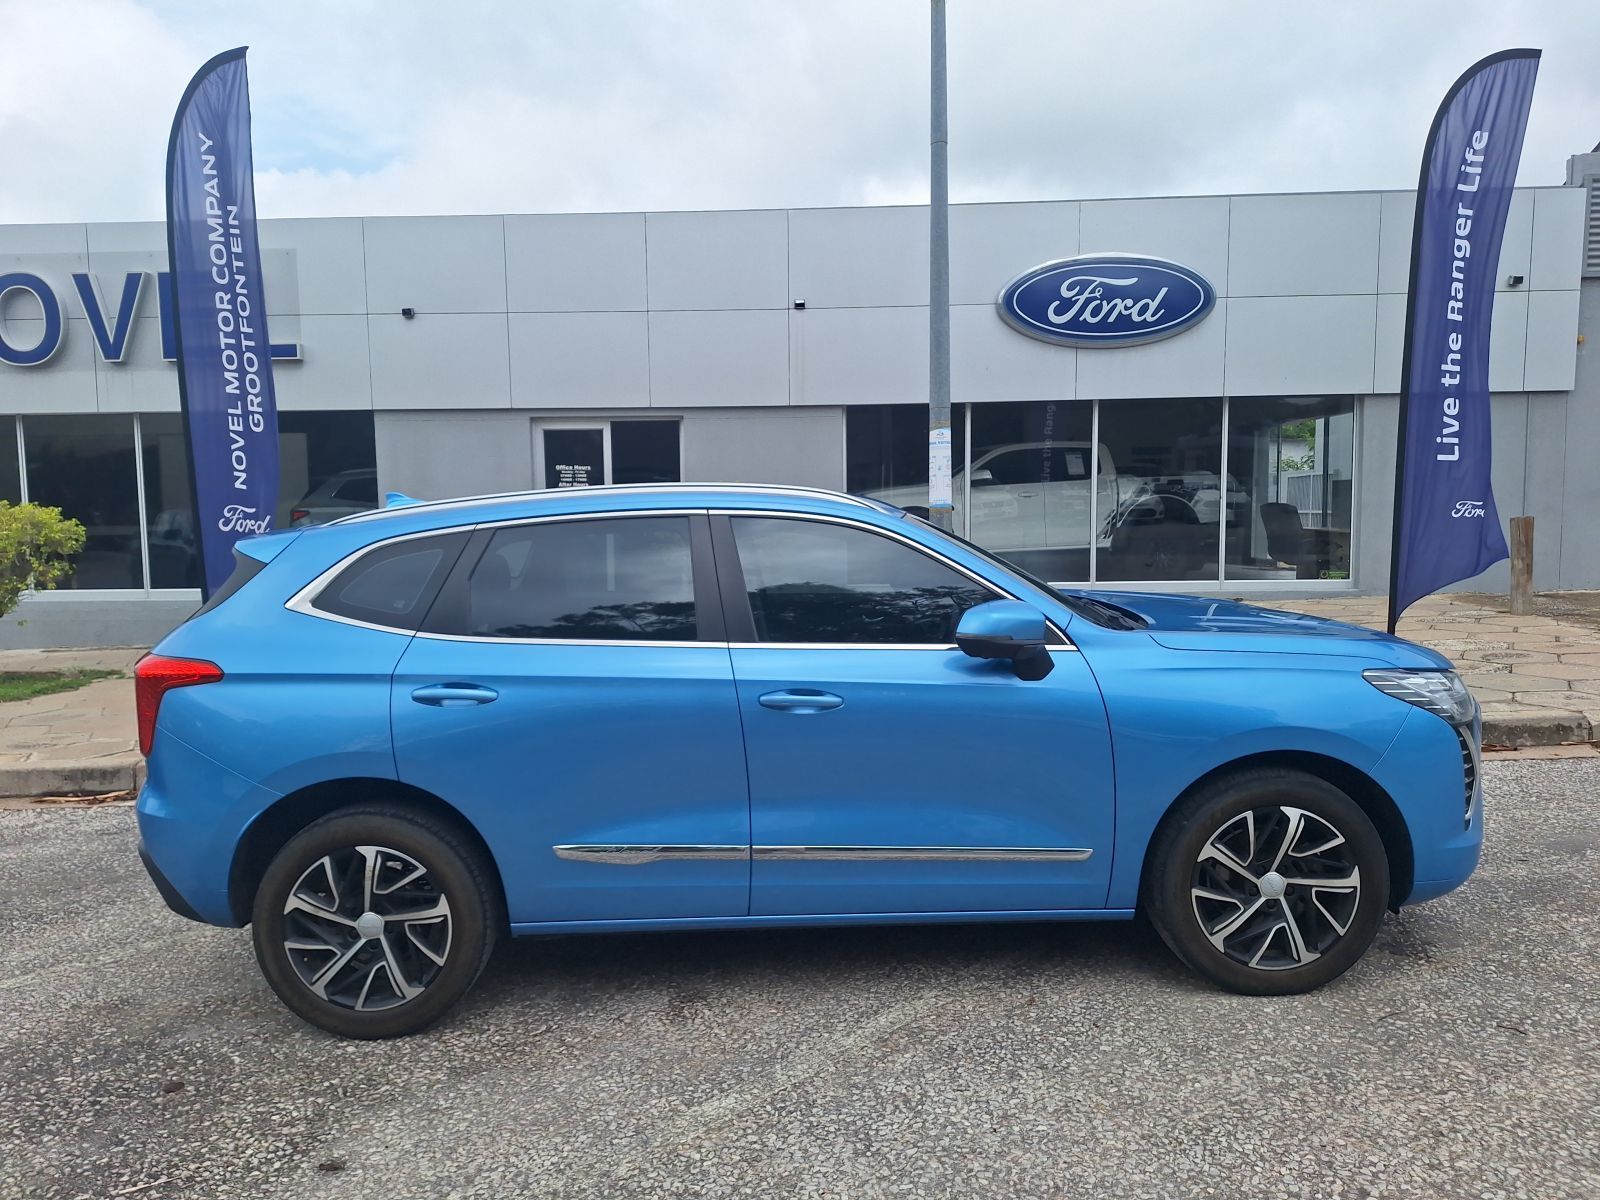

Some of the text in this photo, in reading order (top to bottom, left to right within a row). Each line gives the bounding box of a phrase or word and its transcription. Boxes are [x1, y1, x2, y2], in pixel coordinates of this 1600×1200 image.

[199, 132, 247, 490] NOVEL MOTOR COMPANY
[226, 205, 265, 433] GROOTFONTEIN
[1047, 275, 1169, 324] Ford
[1436, 130, 1489, 461] Live the Ranger Life
[218, 504, 271, 534] Ford
